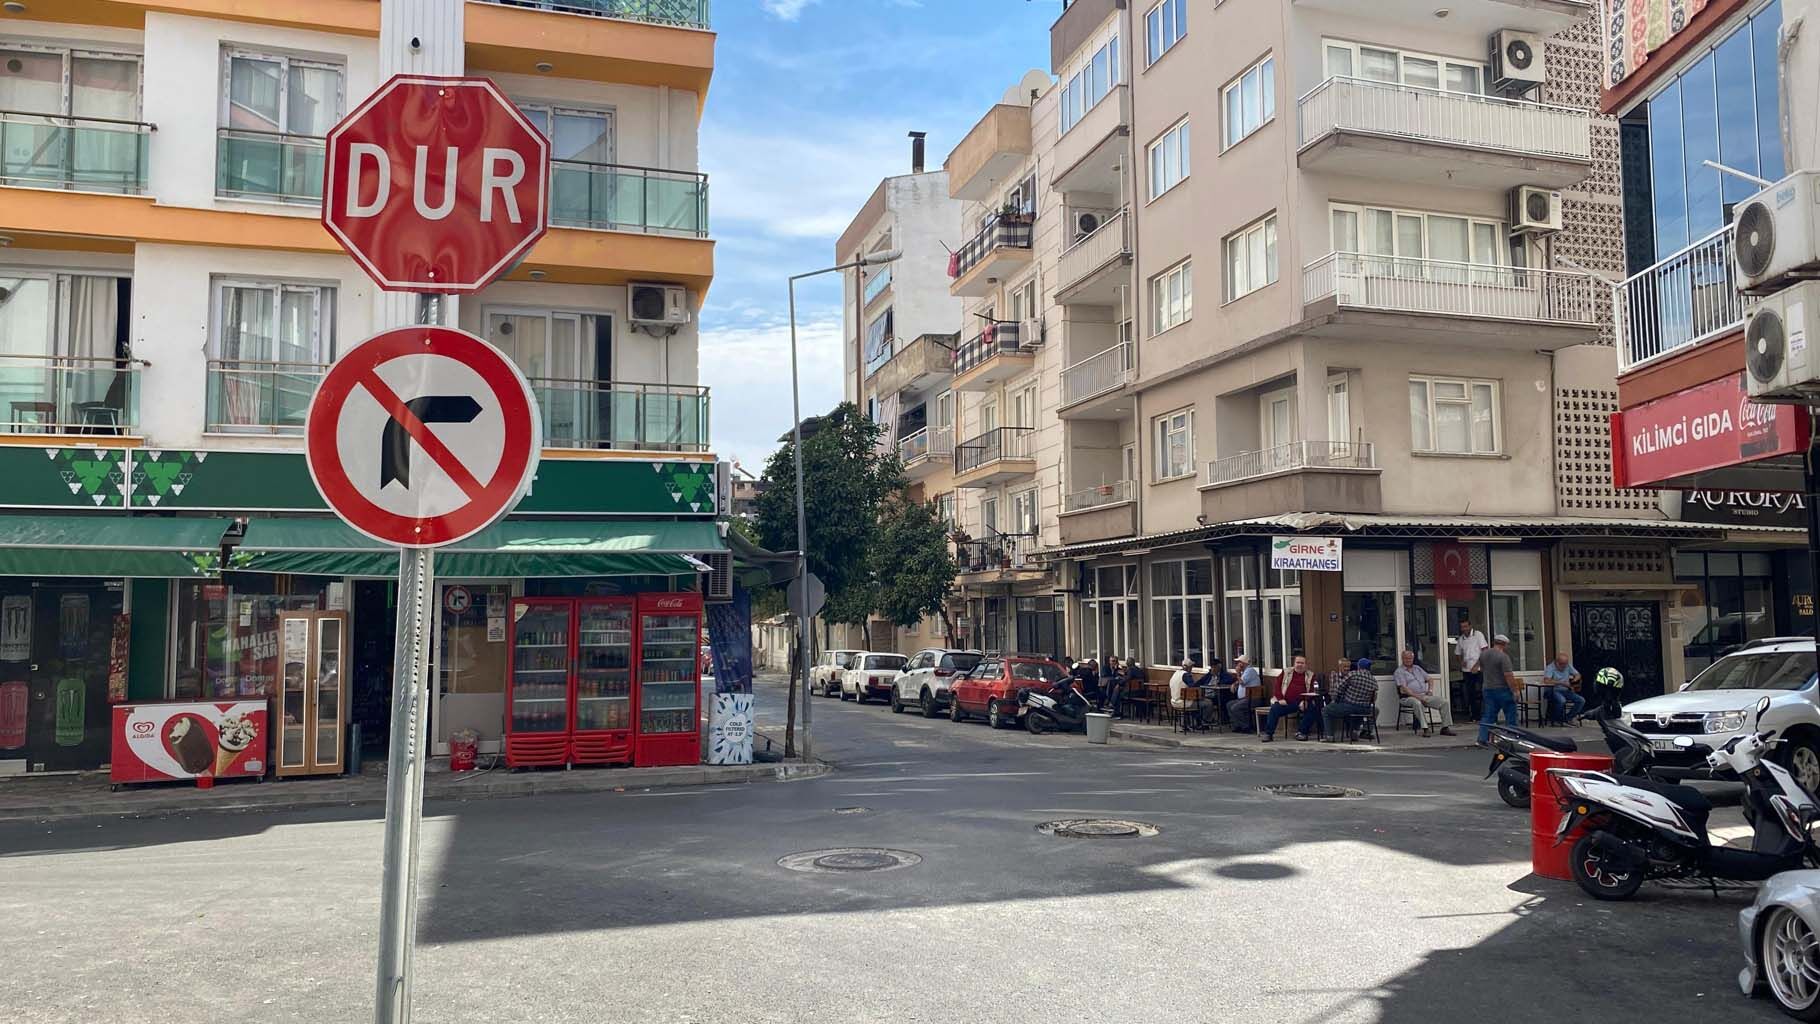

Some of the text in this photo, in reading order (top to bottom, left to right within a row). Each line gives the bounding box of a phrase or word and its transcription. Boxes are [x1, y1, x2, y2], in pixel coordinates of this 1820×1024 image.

[346, 142, 526, 224] DUR
[1633, 409, 1733, 456] KİLİMCİ GIDA
[1687, 490, 1807, 514] AURORA
[1289, 544, 1325, 554] GİRNE
